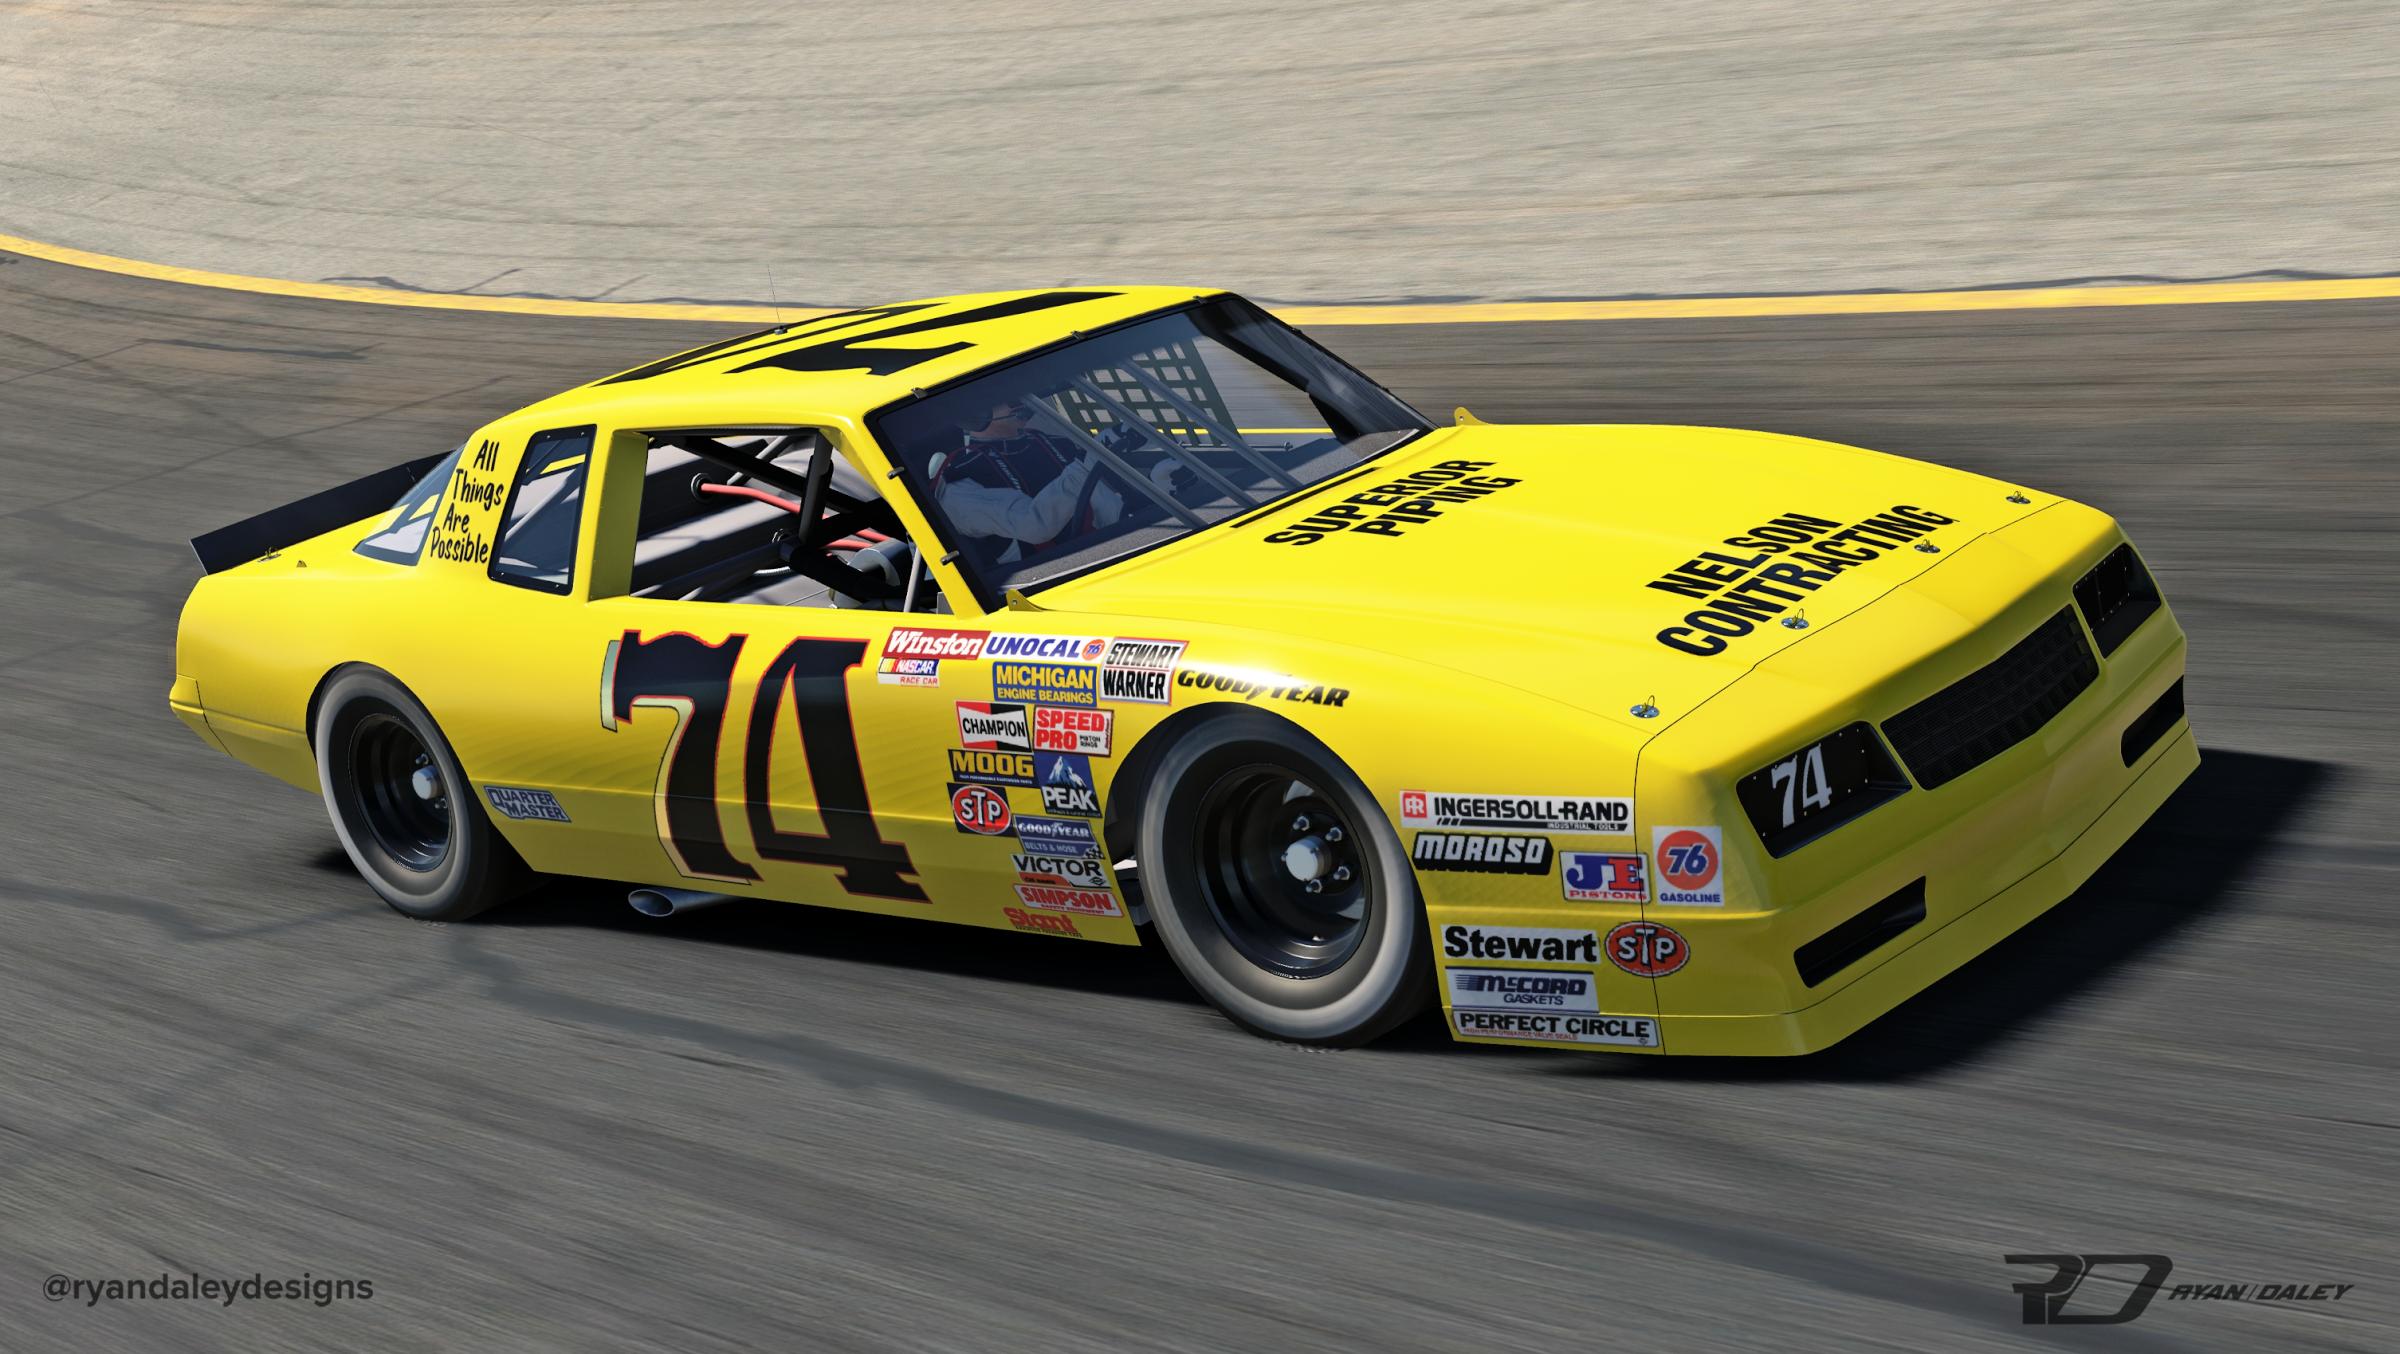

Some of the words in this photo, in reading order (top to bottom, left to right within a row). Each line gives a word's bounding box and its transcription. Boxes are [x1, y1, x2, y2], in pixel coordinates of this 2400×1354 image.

[473, 439, 500, 472] All
[452, 468, 504, 511] Things
[1263, 460, 1498, 546] SUPERIOR
[1349, 476, 1524, 537] PIPING
[442, 502, 470, 533] Are
[430, 526, 489, 564] Possible
[1645, 512, 1844, 600] NELSON
[1656, 504, 1956, 657] CONTRACTING
[887, 630, 984, 656] Winston
[985, 636, 1081, 659] UNOCAL
[1085, 644, 1102, 656] 76
[1106, 642, 1181, 668] STEWART
[896, 659, 935, 674] NASCAR
[996, 665, 1094, 689] MICHIGAN
[900, 676, 920, 684] RACE
[922, 677, 938, 685] CAR
[1103, 669, 1167, 700] WARNER
[996, 687, 1037, 700] ENGINE
[1039, 689, 1094, 704] BEARINGS
[962, 718, 1026, 737] CHAMPION
[1037, 709, 1105, 732] SPEED
[1036, 729, 1078, 750] PRO
[600, 629, 934, 905] 74
[951, 751, 1034, 778] MOOG
[487, 788, 557, 807] QUARTER
[1770, 742, 1832, 828] 74
[505, 802, 566, 819] MASTER
[960, 790, 1002, 826] STP
[1041, 786, 1098, 812] PEAK
[1434, 796, 1628, 821] INGERSOLL-RAND
[1413, 832, 1549, 868] MOROSO
[1667, 844, 1708, 877] 76
[1012, 855, 1102, 876] VICTOR
[1566, 854, 1645, 892] JE
[1020, 887, 1113, 910] SIMPSON
[1568, 889, 1648, 900] PISTONS
[1660, 892, 1721, 903] GASOLINE
[1445, 926, 1598, 962] Stewart
[1617, 927, 1677, 967] STP
[1503, 993, 1564, 1006] GASKETS
[1460, 1013, 1561, 1033] PERFECT
[1565, 1017, 1650, 1038] CIRCLE
